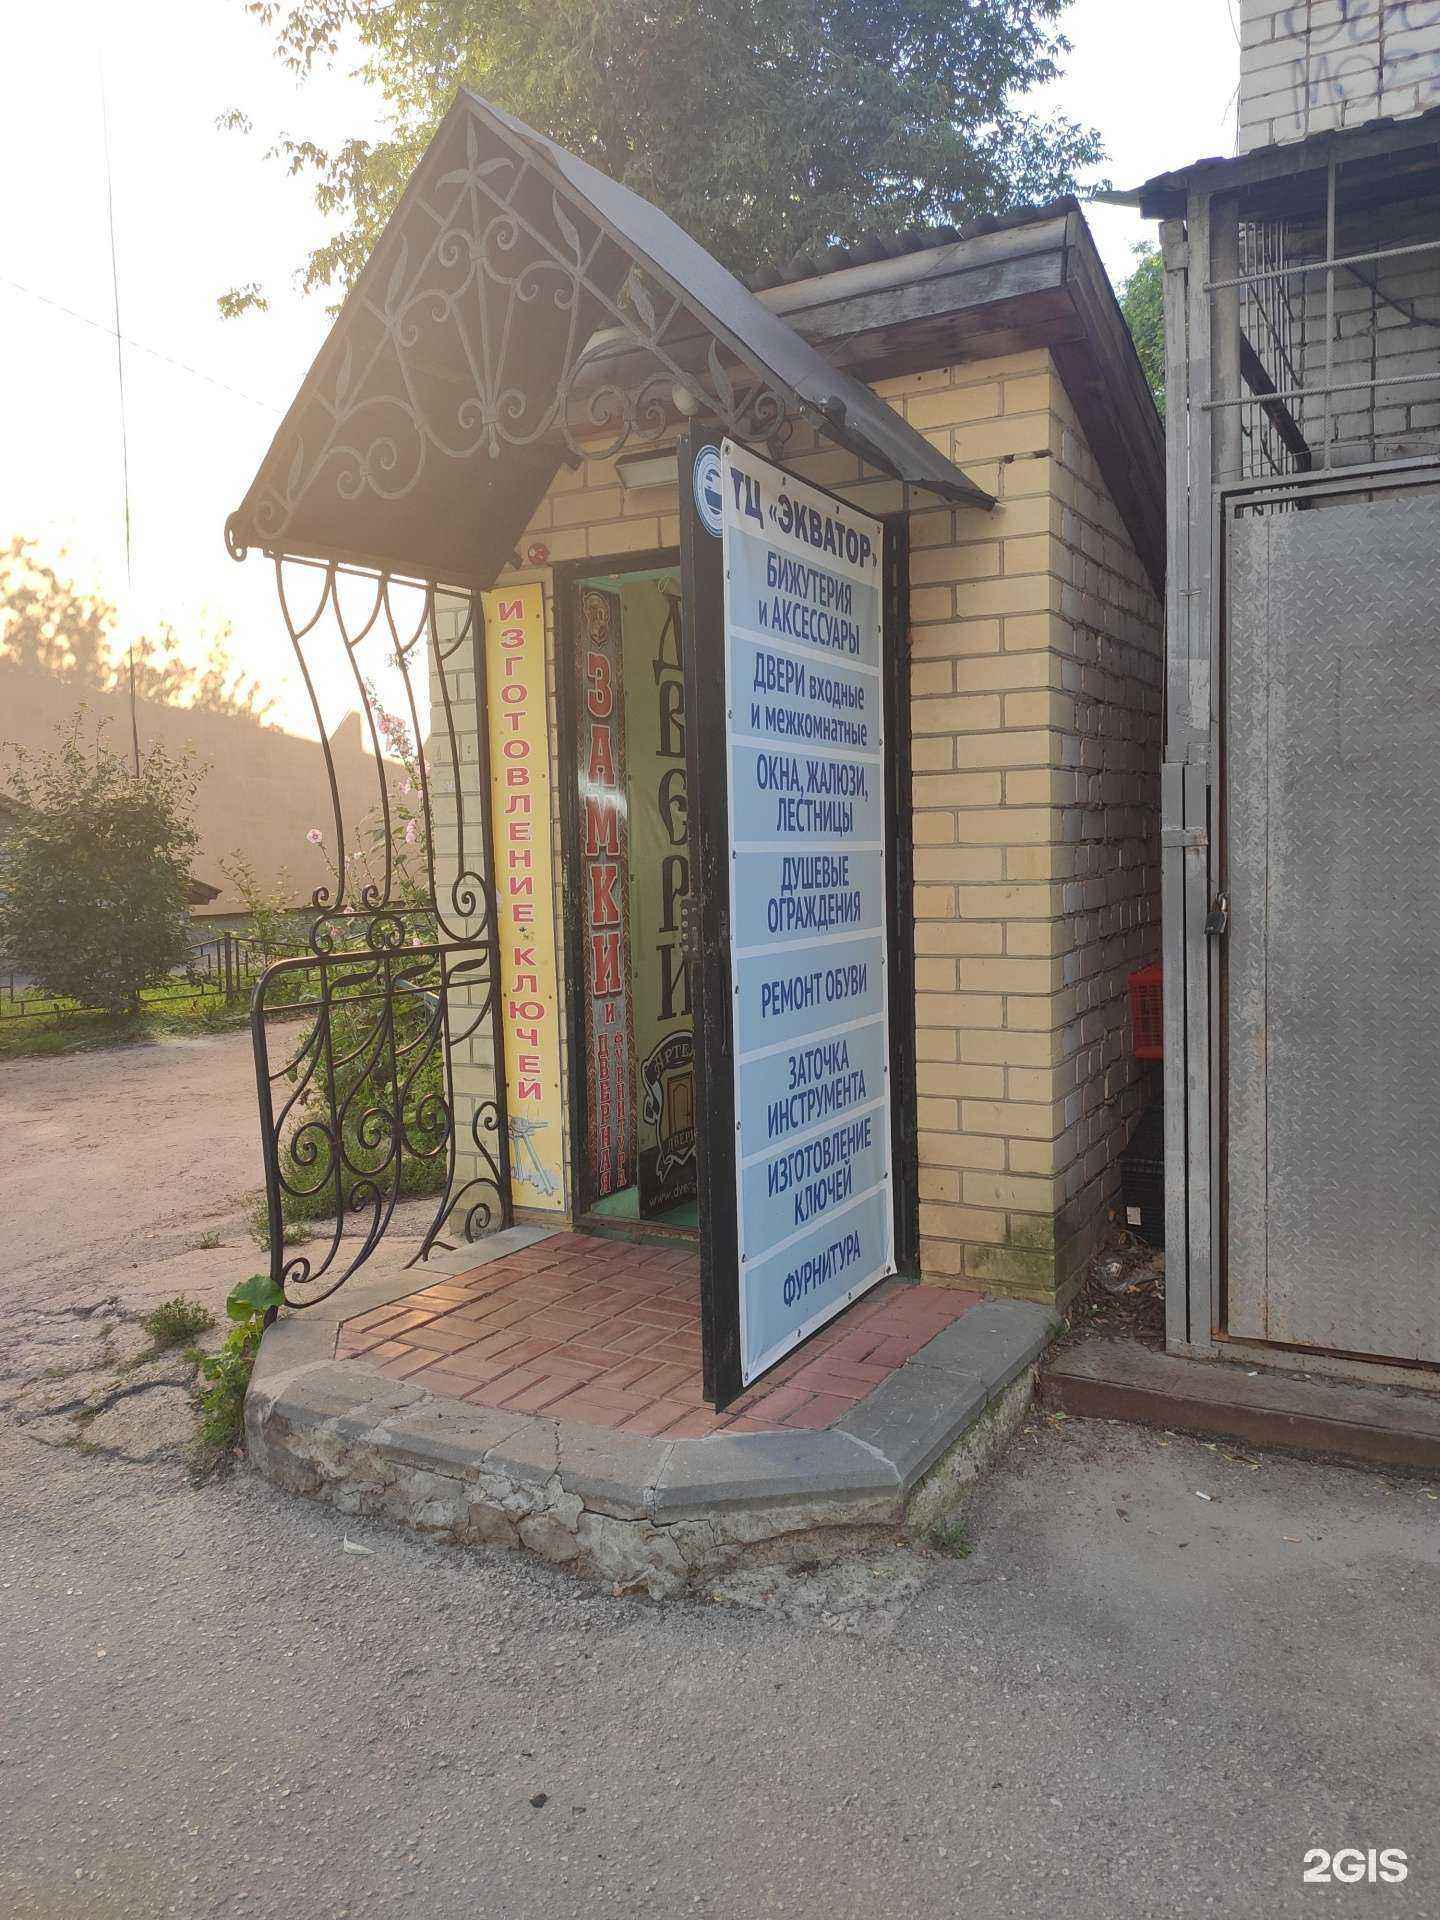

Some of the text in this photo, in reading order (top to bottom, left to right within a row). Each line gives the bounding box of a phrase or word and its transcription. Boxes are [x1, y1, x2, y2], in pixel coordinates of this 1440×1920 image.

[730, 466, 878, 569] ТЦ «ЭКВАТОР»
[766, 550, 852, 616] БИЖУТЕРИЯ
[771, 595, 861, 655] АКСЕССУАРЫ
[753, 651, 865, 711] ДВЕРИ входные
[765, 704, 868, 747] межкомнатные
[756, 753, 869, 803] ОКНА, ЖАЛЮЗИ,
[584, 651, 623, 996] ЗАМКИ
[776, 797, 854, 837] ЛЕСТНИЦЫ
[498, 599, 546, 1101] ИЗГОТОВЛЕНИЕ КЛЮЧЕЙ
[780, 855, 850, 896] ДУШЕВЫЕ
[767, 890, 862, 934] ОГРАЖДЕНИЯ
[761, 962, 868, 1019] РЕМОНТ ОБУВИ
[788, 1038, 849, 1091] ЗАТОЧКА
[767, 1068, 867, 1139] ИНСТРУМЕНТА
[767, 1115, 872, 1199] ИЗГОТОВЛЕНИЕ
[793, 1159, 853, 1227] КЛЮЧЕЙ
[782, 1229, 861, 1307] ФУРНИТУРА
